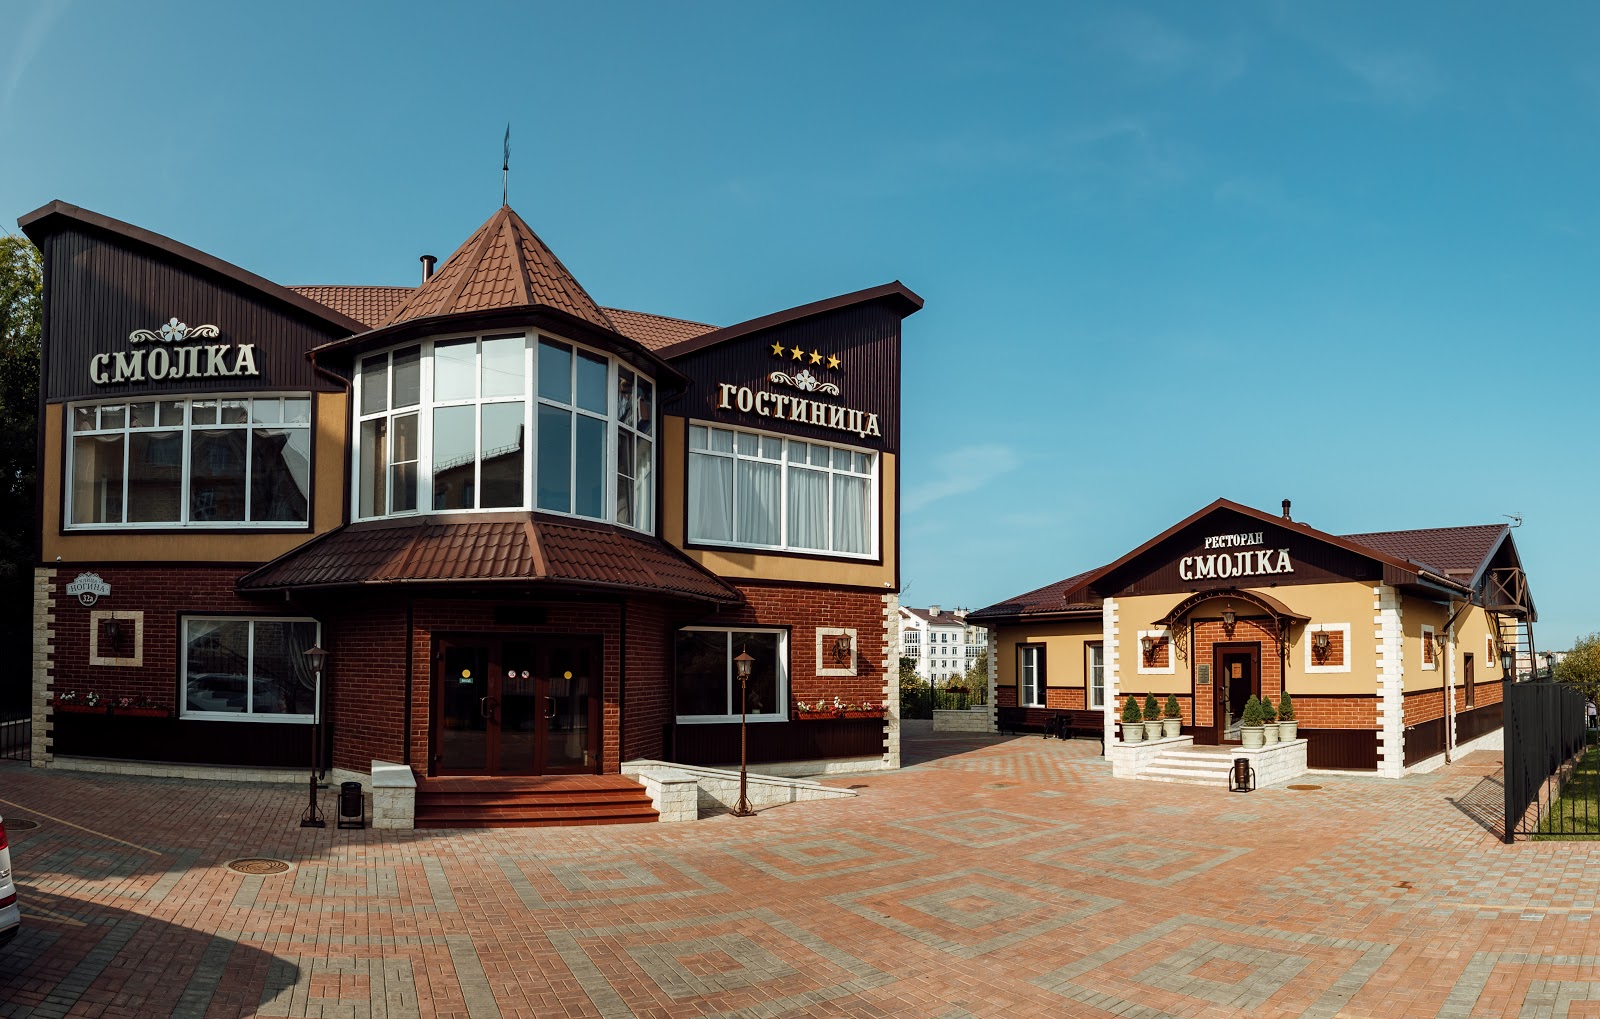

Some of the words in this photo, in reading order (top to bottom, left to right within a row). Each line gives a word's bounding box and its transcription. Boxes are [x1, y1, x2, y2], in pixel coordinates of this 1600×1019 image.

[90, 343, 259, 385] СМОЛКА
[718, 383, 881, 438] ГОСТИНИЦА
[1204, 532, 1264, 549] РЕСТОРАН
[1179, 548, 1294, 580] СМОЛКА
[70, 583, 105, 592] НОГИНА
[82, 594, 94, 602] 32а
